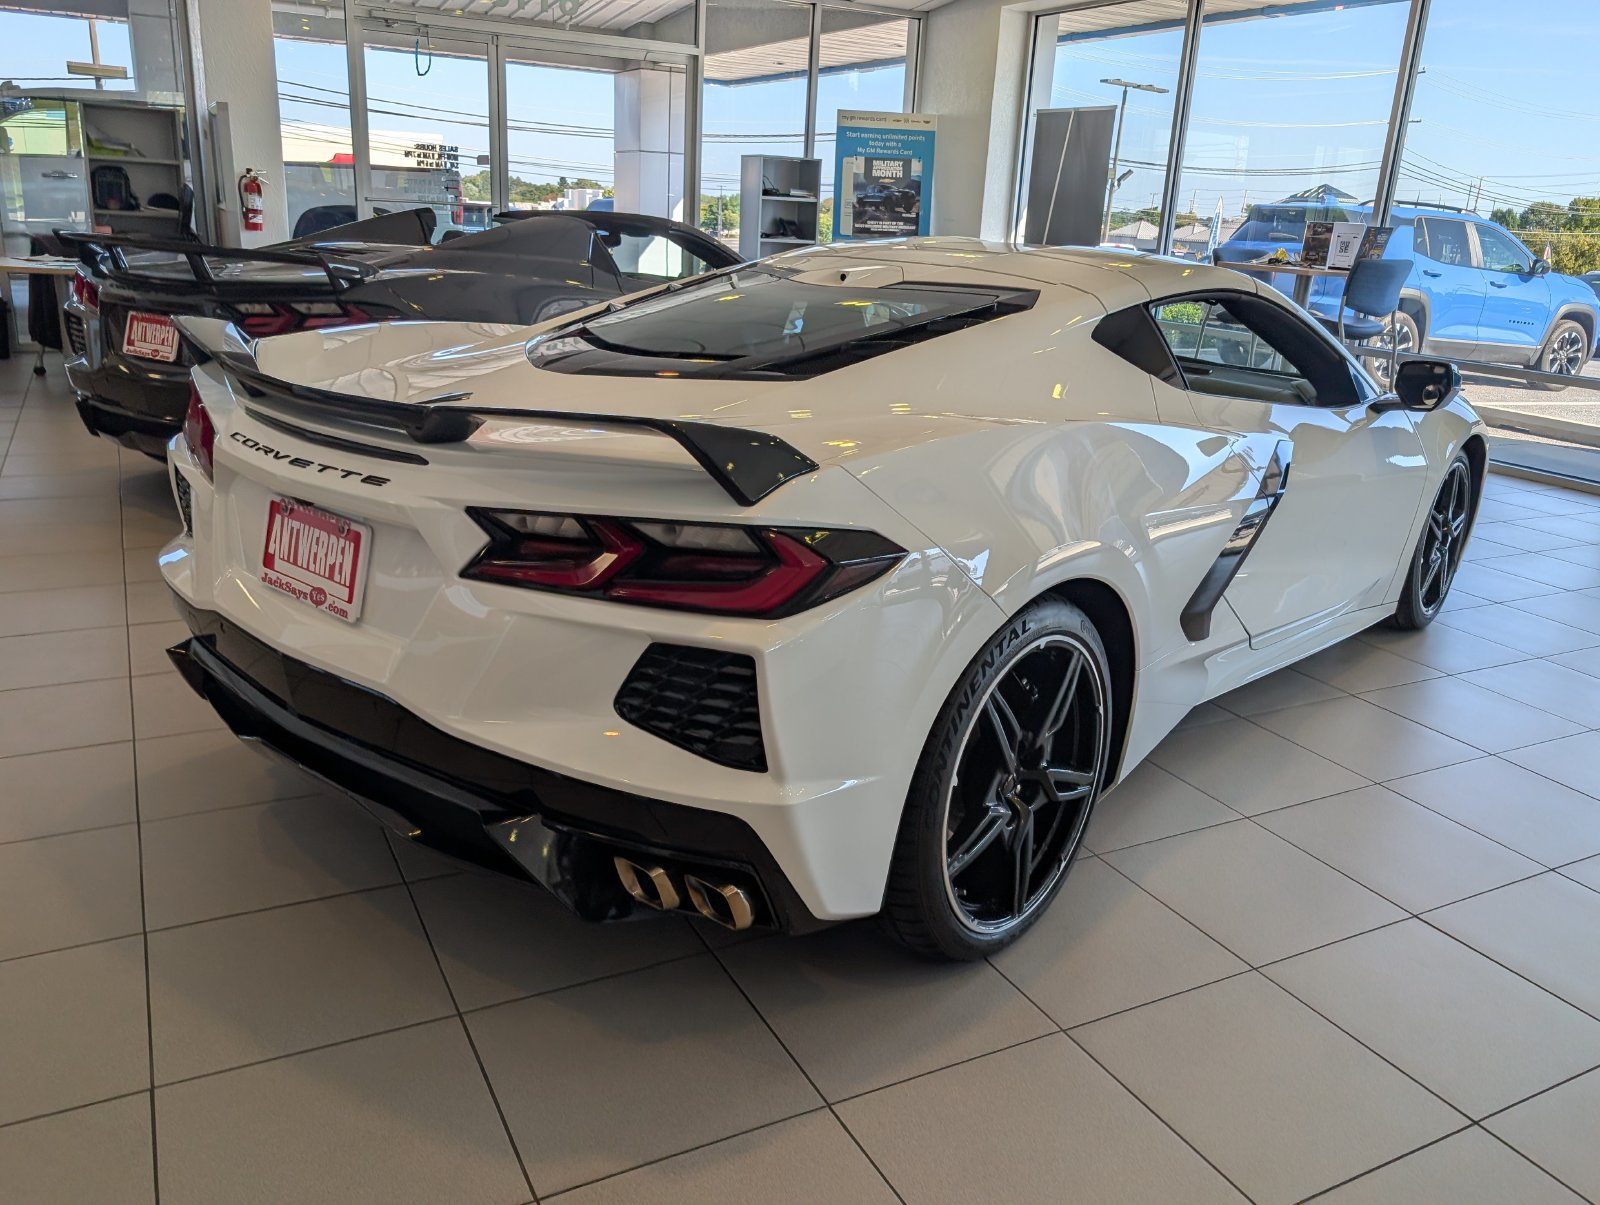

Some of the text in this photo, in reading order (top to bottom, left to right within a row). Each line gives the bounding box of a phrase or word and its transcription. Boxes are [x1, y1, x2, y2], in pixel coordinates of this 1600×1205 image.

[882, 133, 907, 141] unlimited
[872, 170, 903, 178] MONTH
[130, 320, 174, 347] ANTWERPEN
[230, 432, 391, 486] CORVETTE
[268, 513, 354, 587] ANTWERPEN
[261, 572, 309, 600] JackSays
